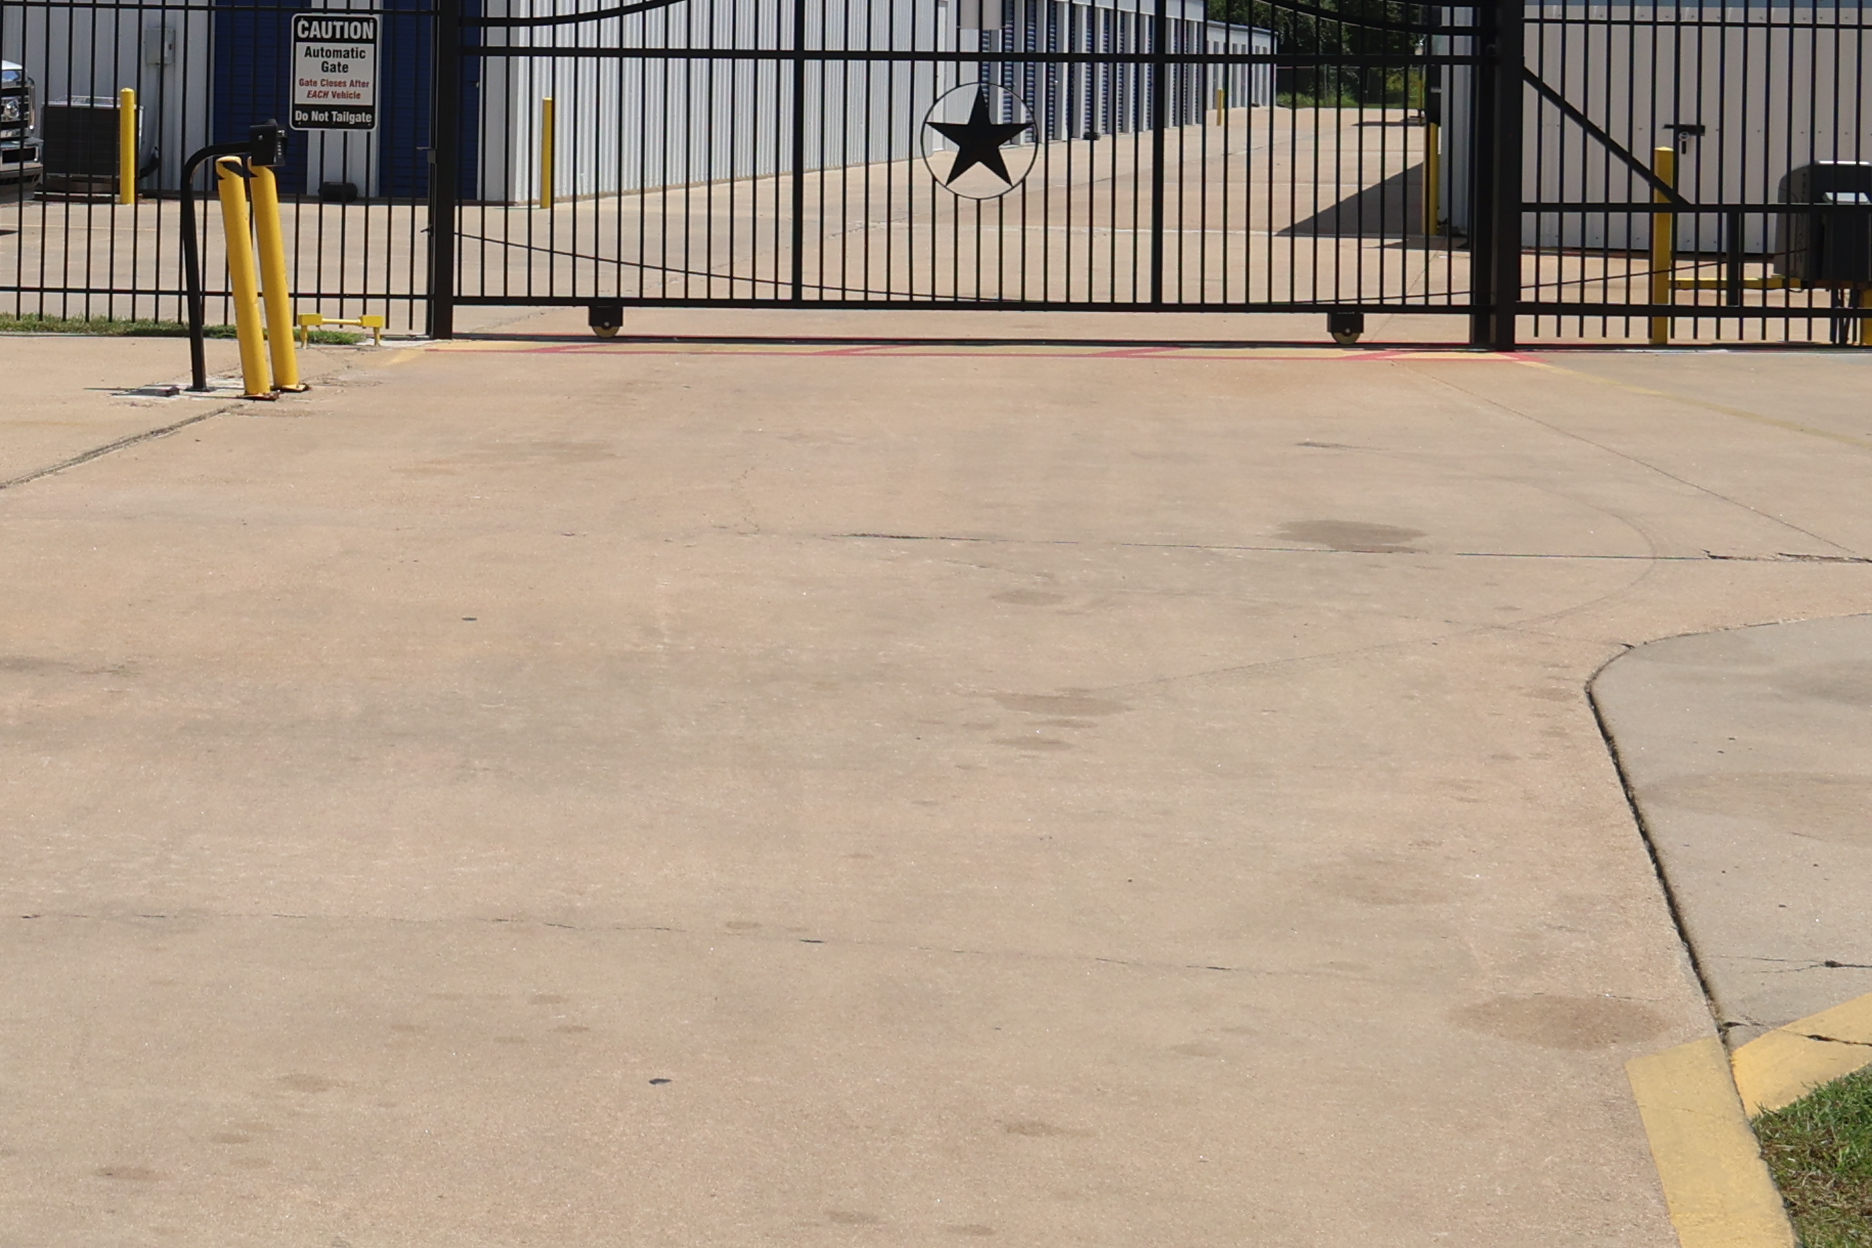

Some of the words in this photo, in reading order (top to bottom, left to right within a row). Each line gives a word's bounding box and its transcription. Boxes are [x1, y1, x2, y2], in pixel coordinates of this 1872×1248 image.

[297, 20, 374, 39] CAUTION
[304, 46, 366, 59] Automatic
[321, 61, 349, 73] Gate
[299, 78, 317, 87] Gate
[320, 78, 347, 87] Closes
[349, 79, 370, 87] After
[306, 90, 329, 99] EACH
[331, 91, 361, 99] Vehicle
[295, 110, 308, 121] Do
[311, 111, 329, 122] Not
[332, 111, 372, 124] Tailgate
